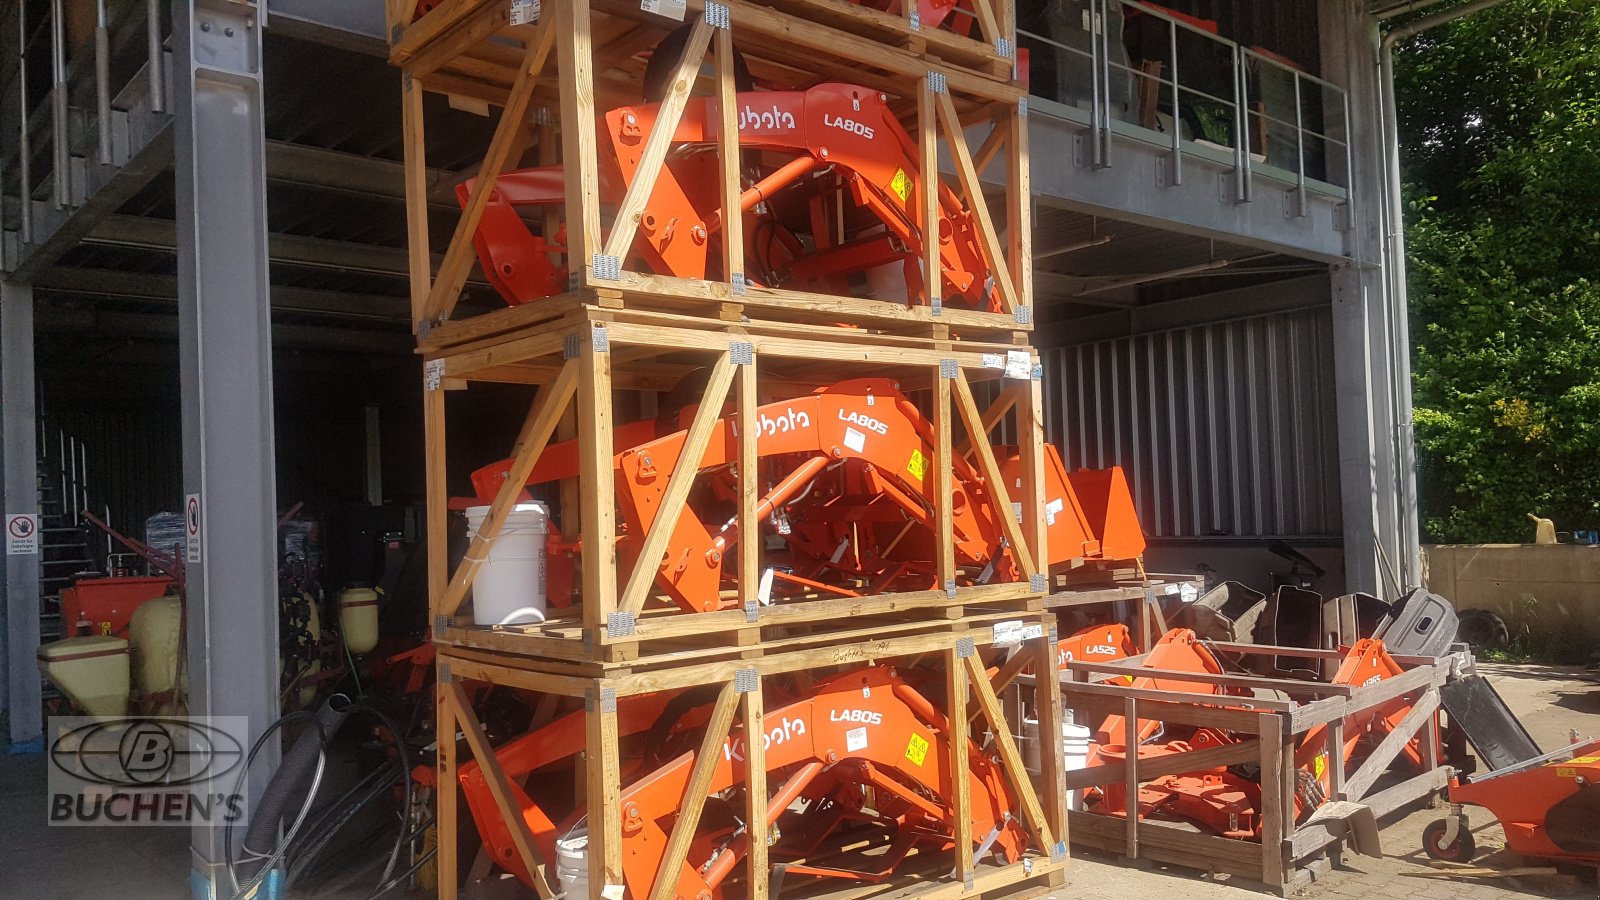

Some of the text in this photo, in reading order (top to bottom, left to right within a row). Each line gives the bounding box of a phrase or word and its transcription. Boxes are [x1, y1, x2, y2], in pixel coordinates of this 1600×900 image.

[824, 113, 875, 140] LA805
[838, 408, 889, 435] LA805
[1086, 645, 1117, 656] LA525
[829, 709, 883, 725] LA805
